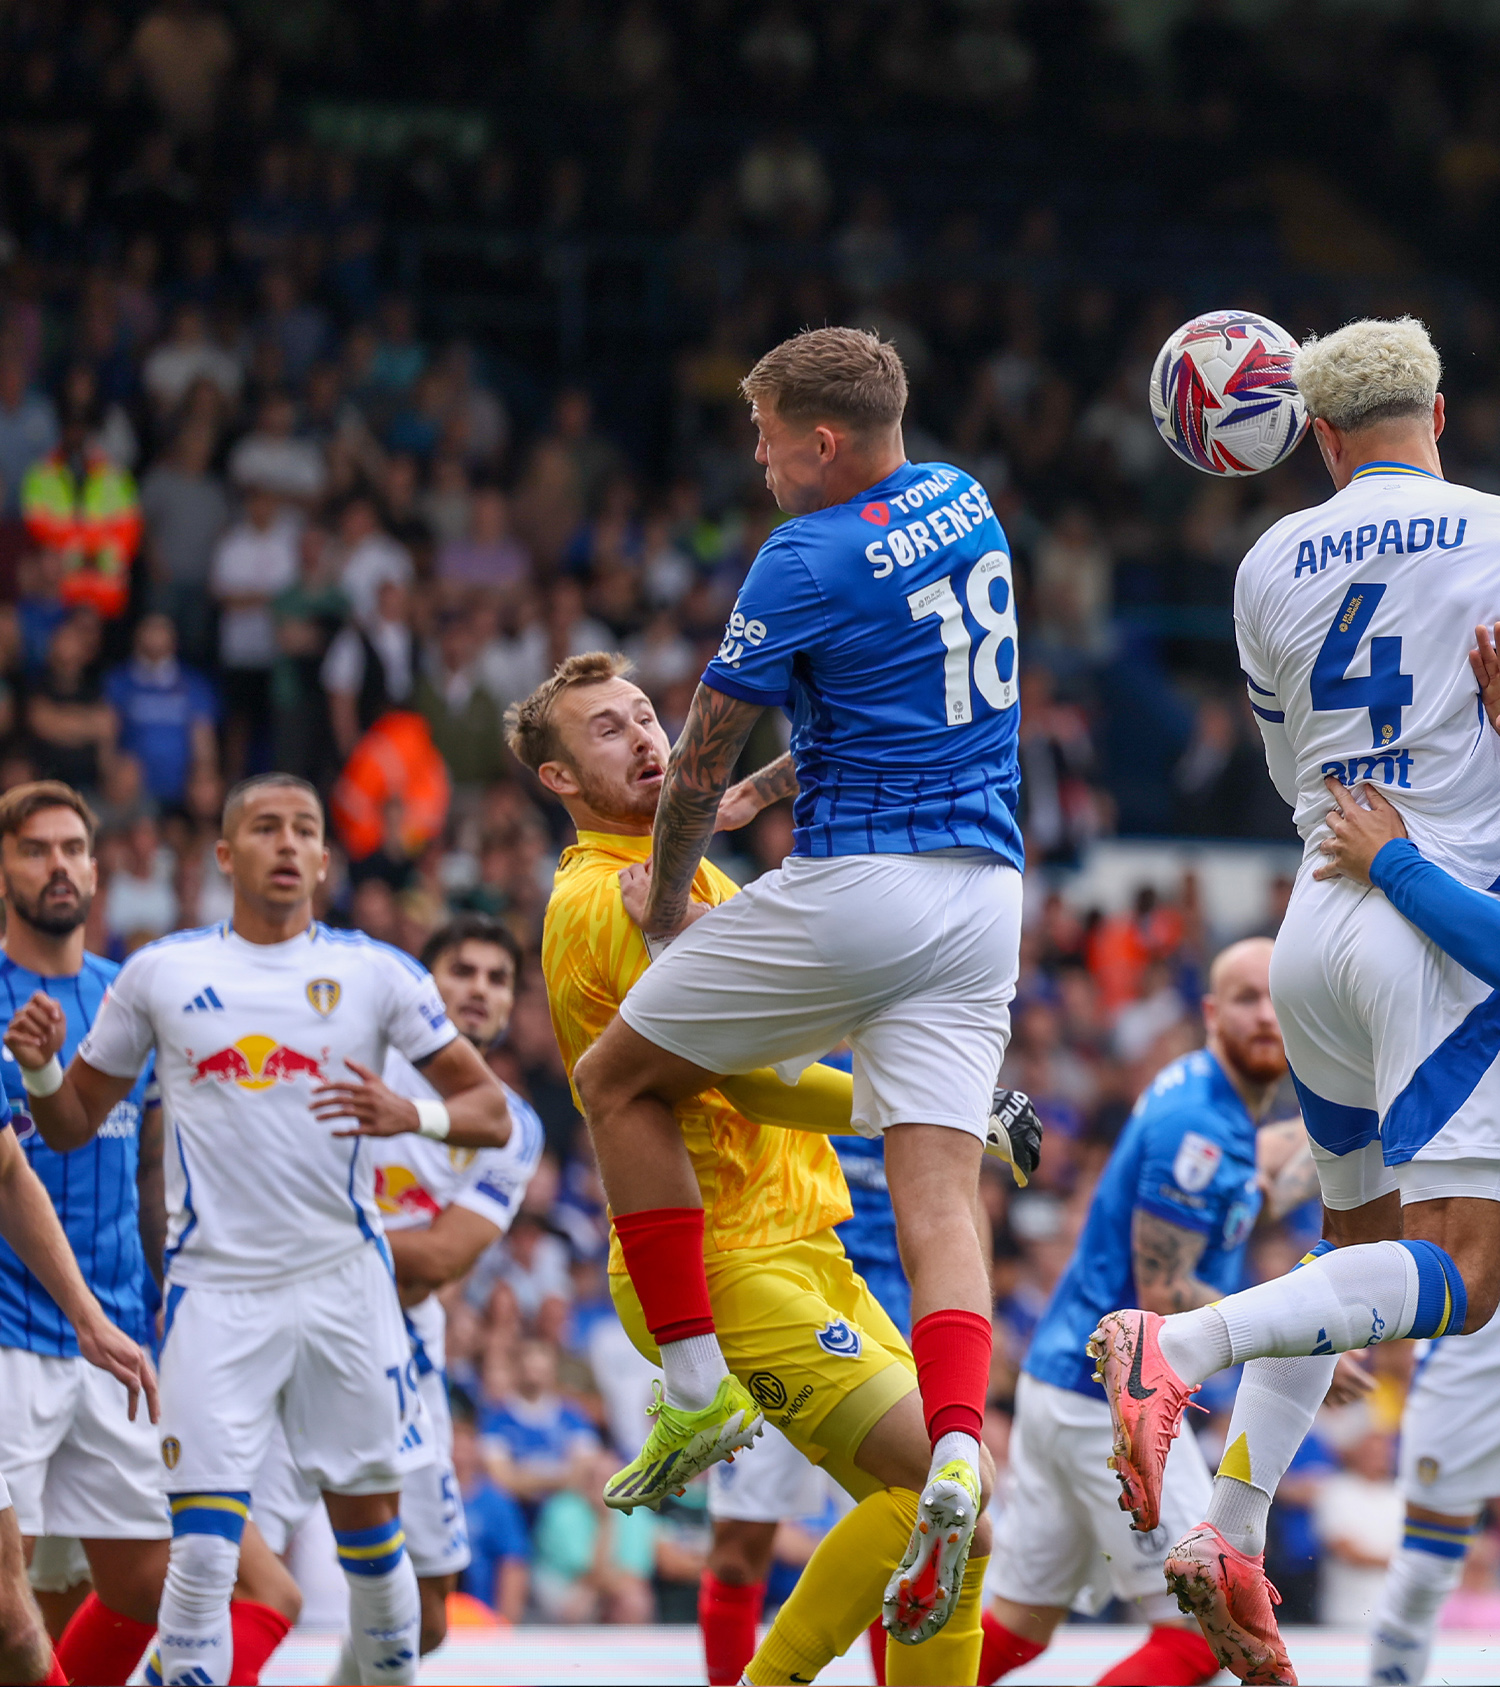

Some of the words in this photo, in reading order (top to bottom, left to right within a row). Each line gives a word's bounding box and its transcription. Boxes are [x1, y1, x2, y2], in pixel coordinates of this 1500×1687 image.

[1294, 516, 1468, 579] AMPADU
[906, 550, 1019, 726] 18
[1311, 583, 1413, 749] 4
[1321, 748, 1415, 789] amt
